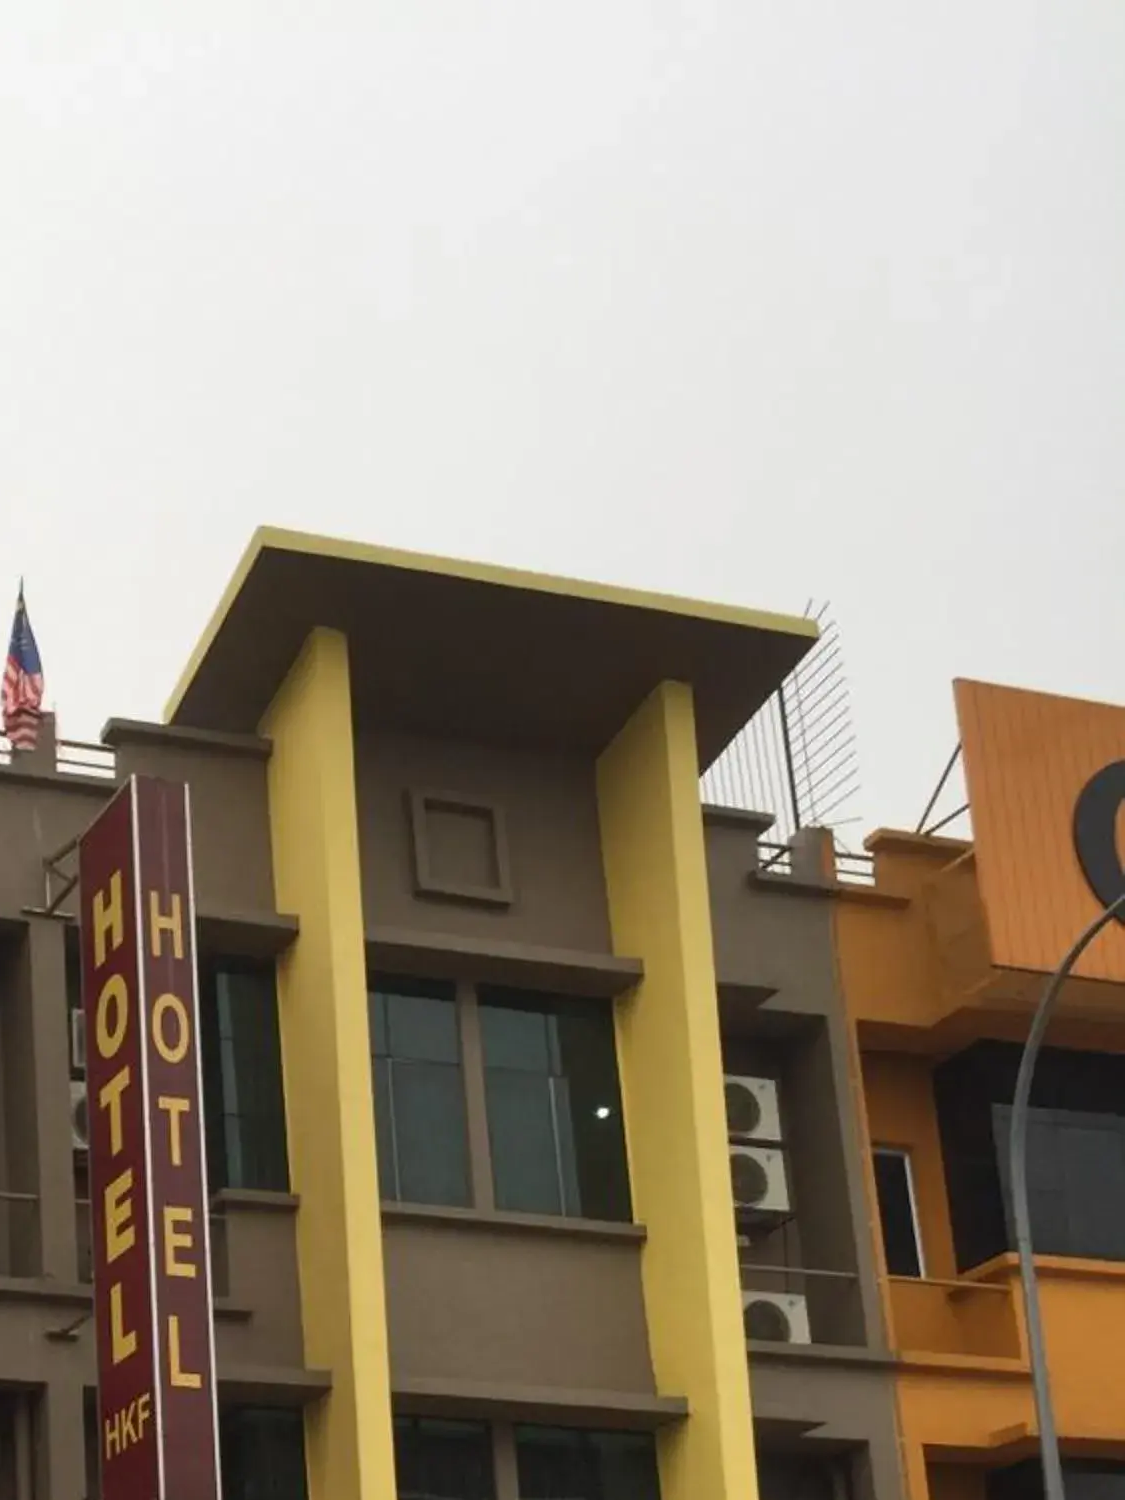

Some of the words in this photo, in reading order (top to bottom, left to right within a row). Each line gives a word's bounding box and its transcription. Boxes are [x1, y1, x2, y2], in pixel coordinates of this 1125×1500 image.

[93, 869, 137, 1364] HOTEL
[150, 890, 203, 1389] HOTEL
[106, 1393, 152, 1460] HKF
